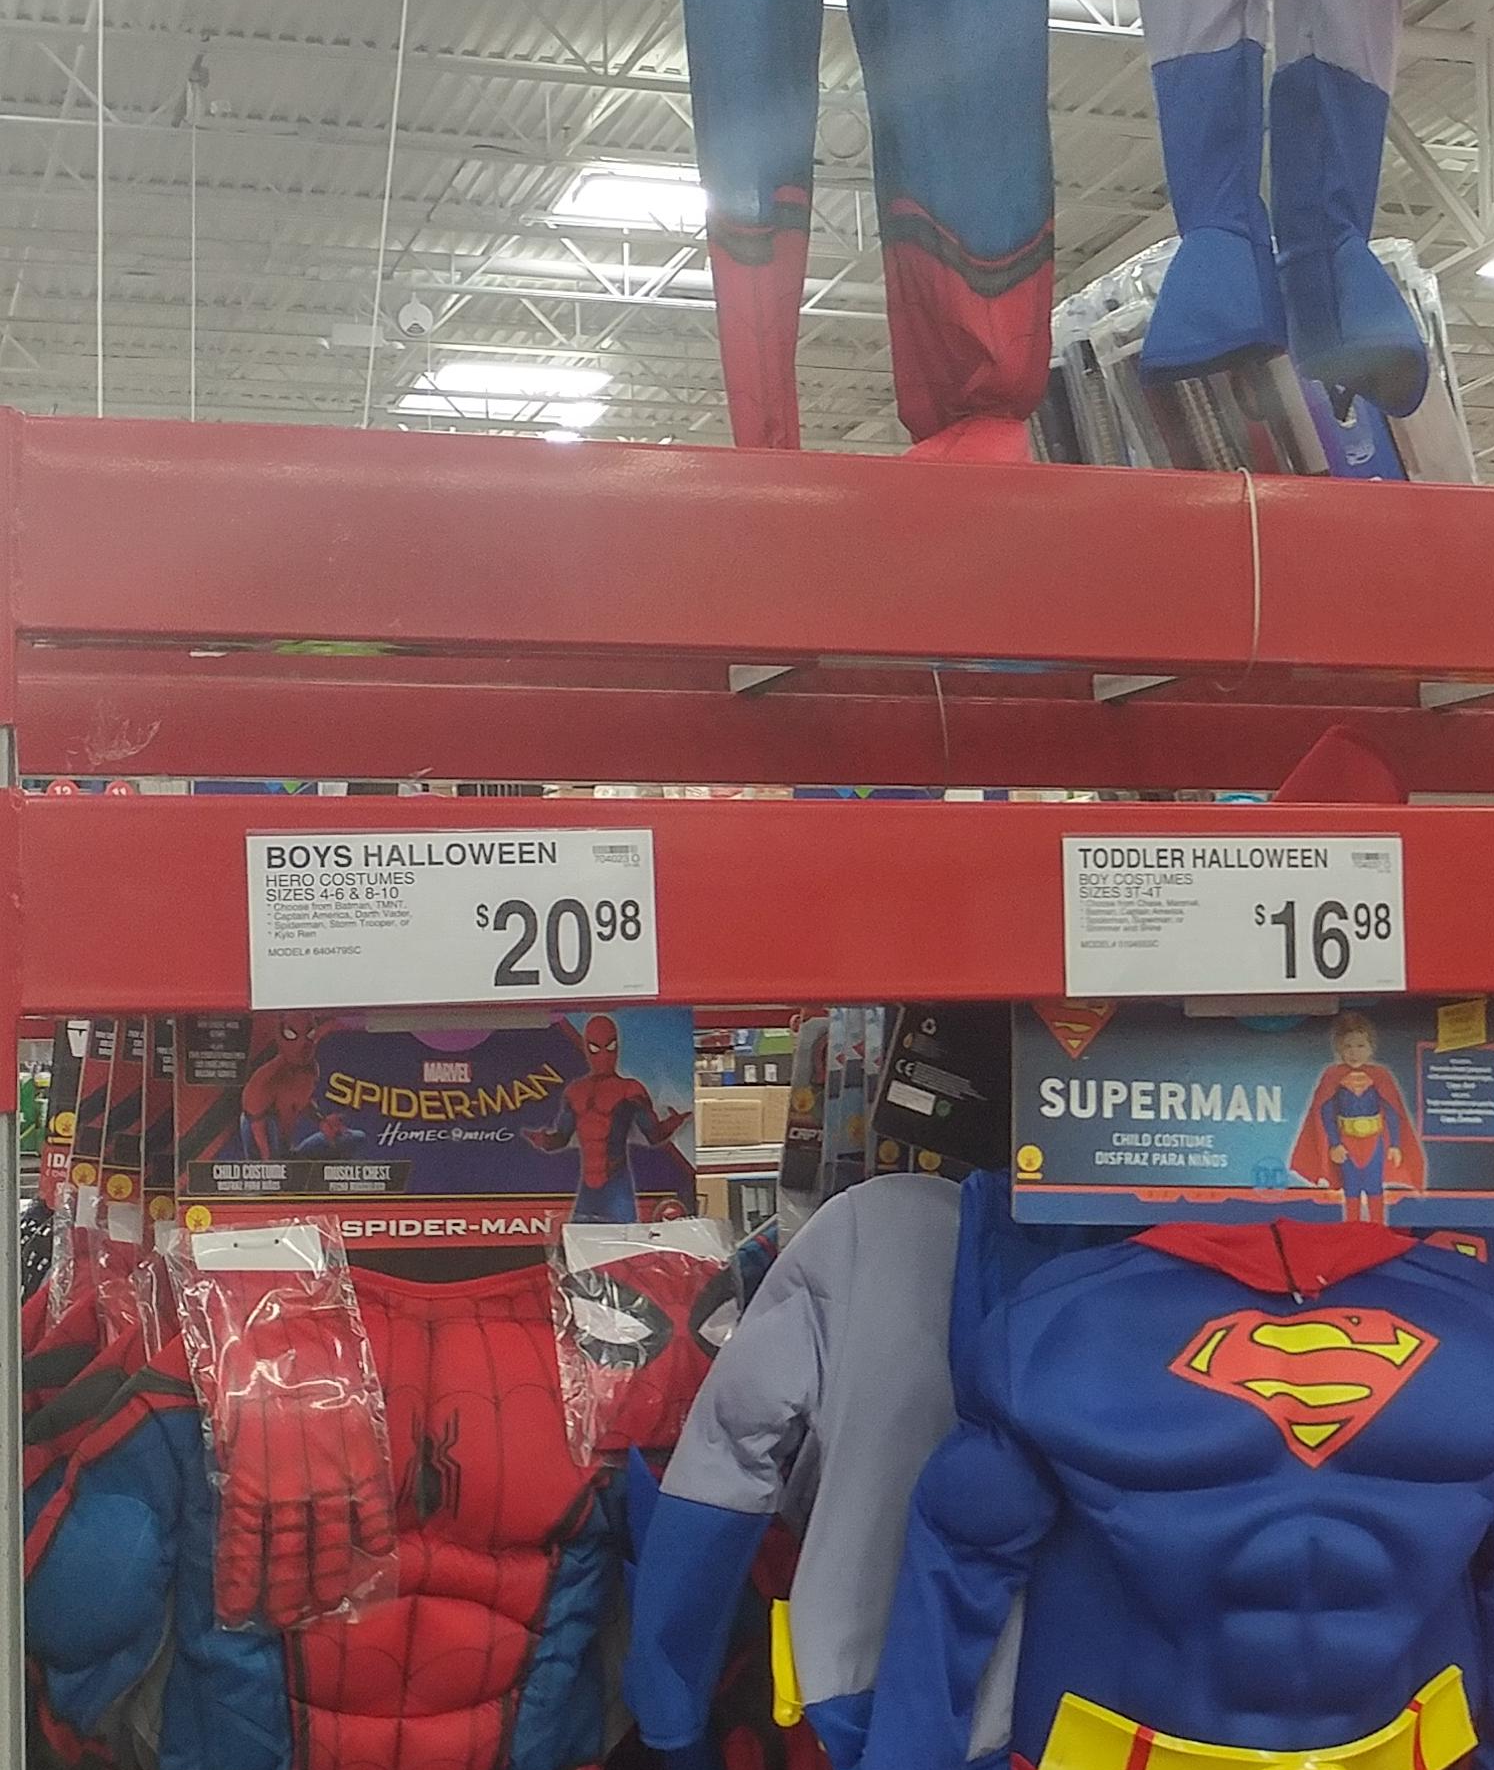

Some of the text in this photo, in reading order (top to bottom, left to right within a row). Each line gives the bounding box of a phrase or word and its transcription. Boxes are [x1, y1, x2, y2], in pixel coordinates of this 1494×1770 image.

[265, 842, 557, 869] BOYS HALLOWEEN
[1078, 848, 1328, 869] TODDLER HALLOWEEN
[265, 871, 415, 888] HERO COSTUMES
[1080, 873, 1193, 885] BOY COSTUMES
[265, 886, 400, 902] SIZES 4-6 & 8-10
[1080, 886, 1121, 898] SIZES
[423, 1061, 472, 1083] MARVEL
[325, 1063, 566, 1122] SPIDER-MAN
[1039, 1077, 1282, 1122] SUPERMAN
[1112, 1133, 1215, 1148] CHILD COSTUME
[1095, 1151, 1149, 1166] DISFRAZ
[1152, 1152, 1185, 1166] PARA
[213, 1165, 240, 1179] CHILD
[342, 1216, 552, 1238] SPIDER-MAN
